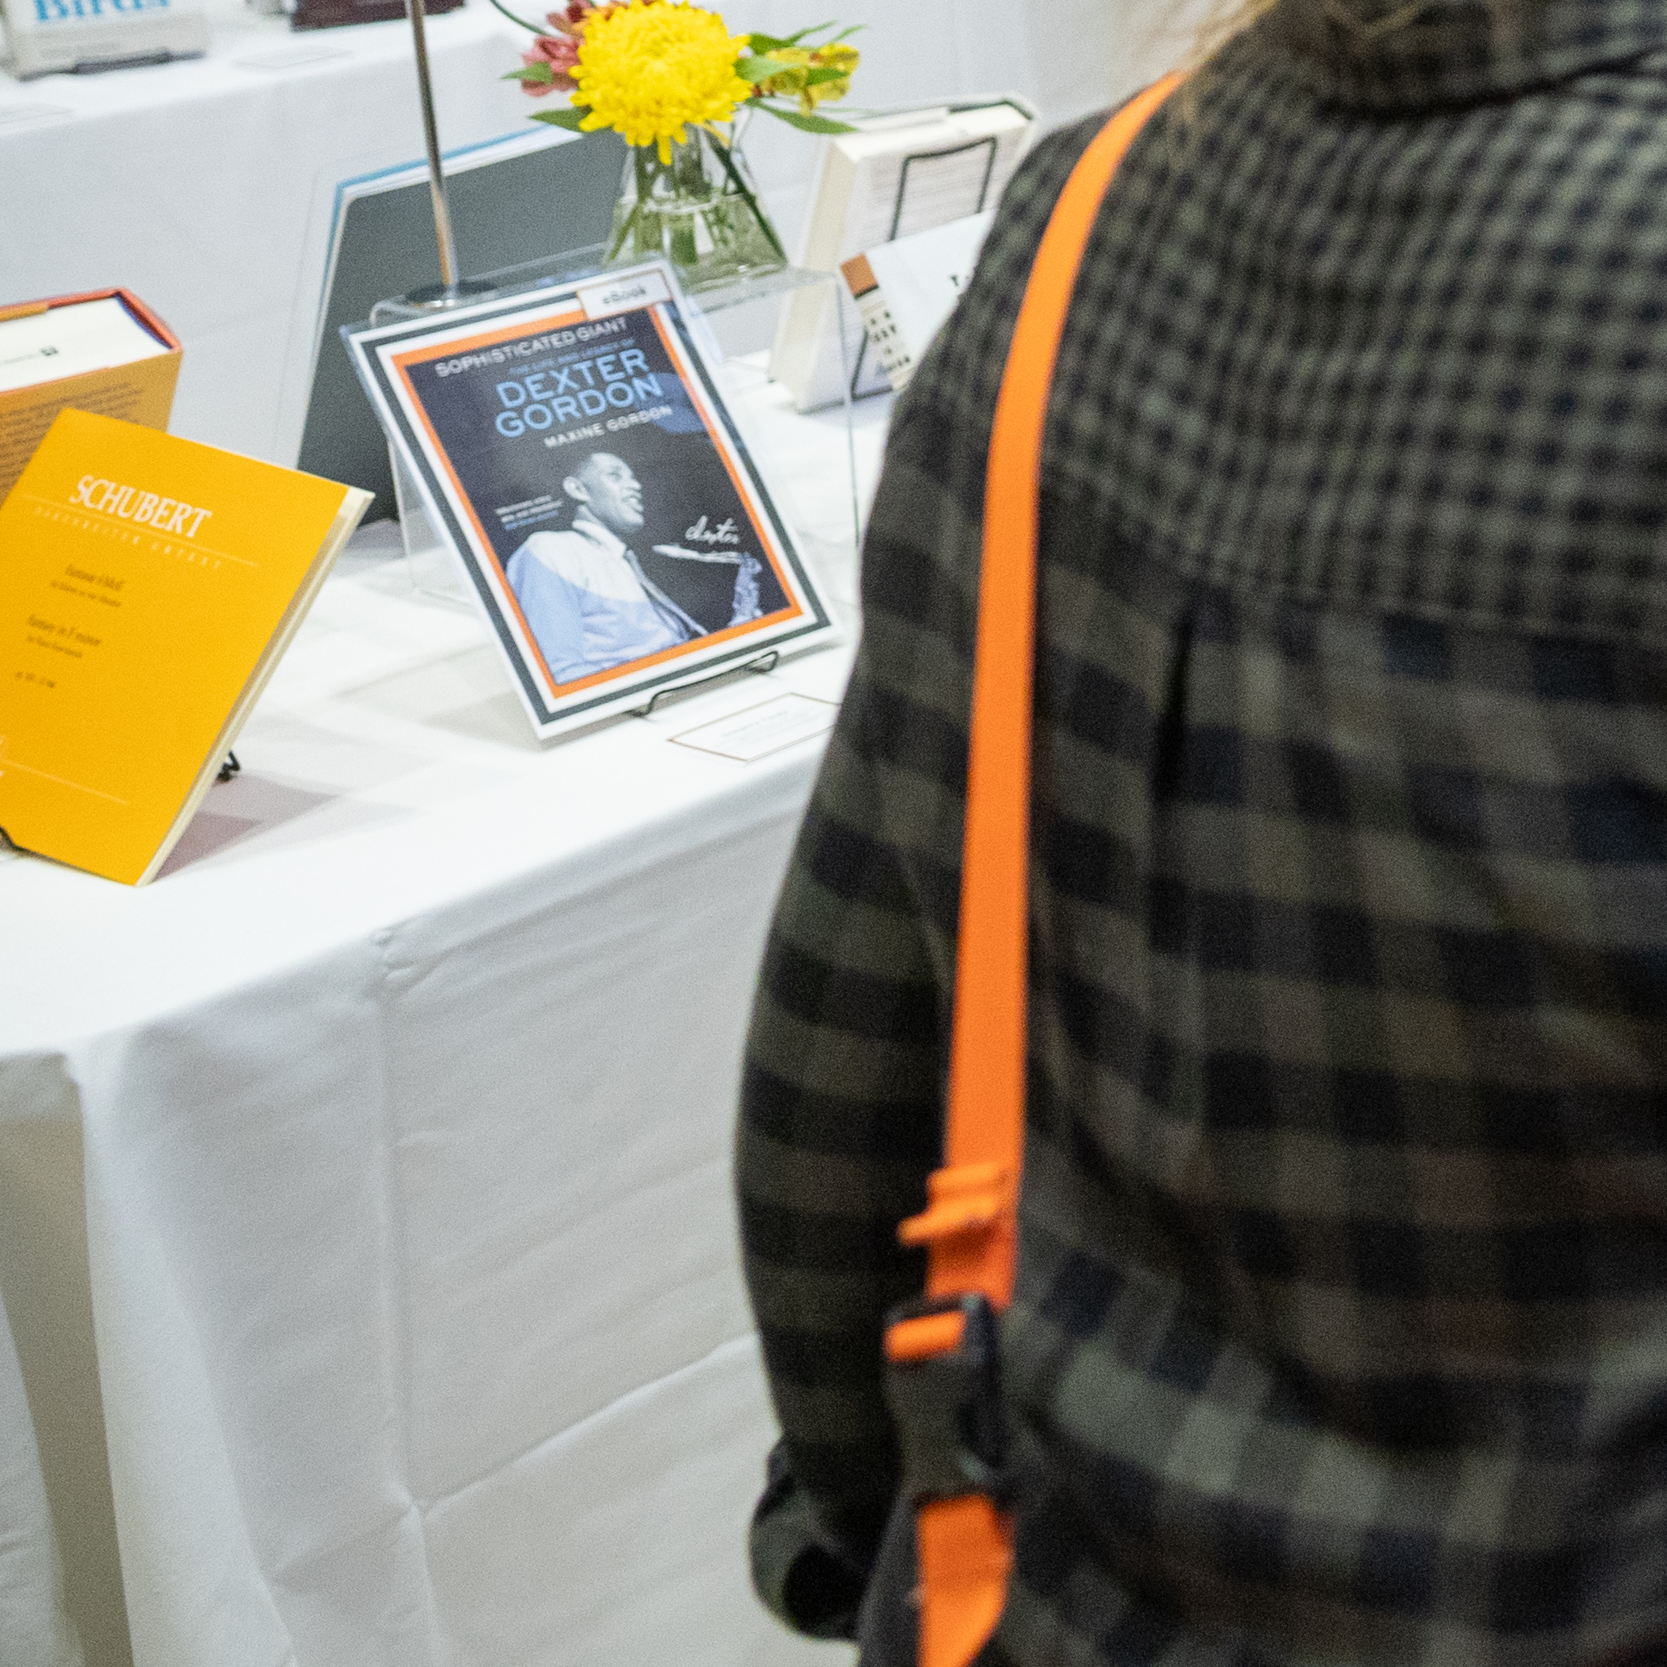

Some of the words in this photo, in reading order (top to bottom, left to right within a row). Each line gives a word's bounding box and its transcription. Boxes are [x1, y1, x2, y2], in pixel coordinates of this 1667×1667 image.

[602, 285, 648, 306] eBook
[434, 330, 576, 378] SOPHISTICATED
[575, 315, 628, 341] GIANT
[495, 372, 664, 438] GORDON
[496, 347, 650, 409] DEXTER
[544, 422, 605, 449] MAXINE
[606, 405, 674, 433] GORDON
[69, 474, 213, 539] SCHUBERT
